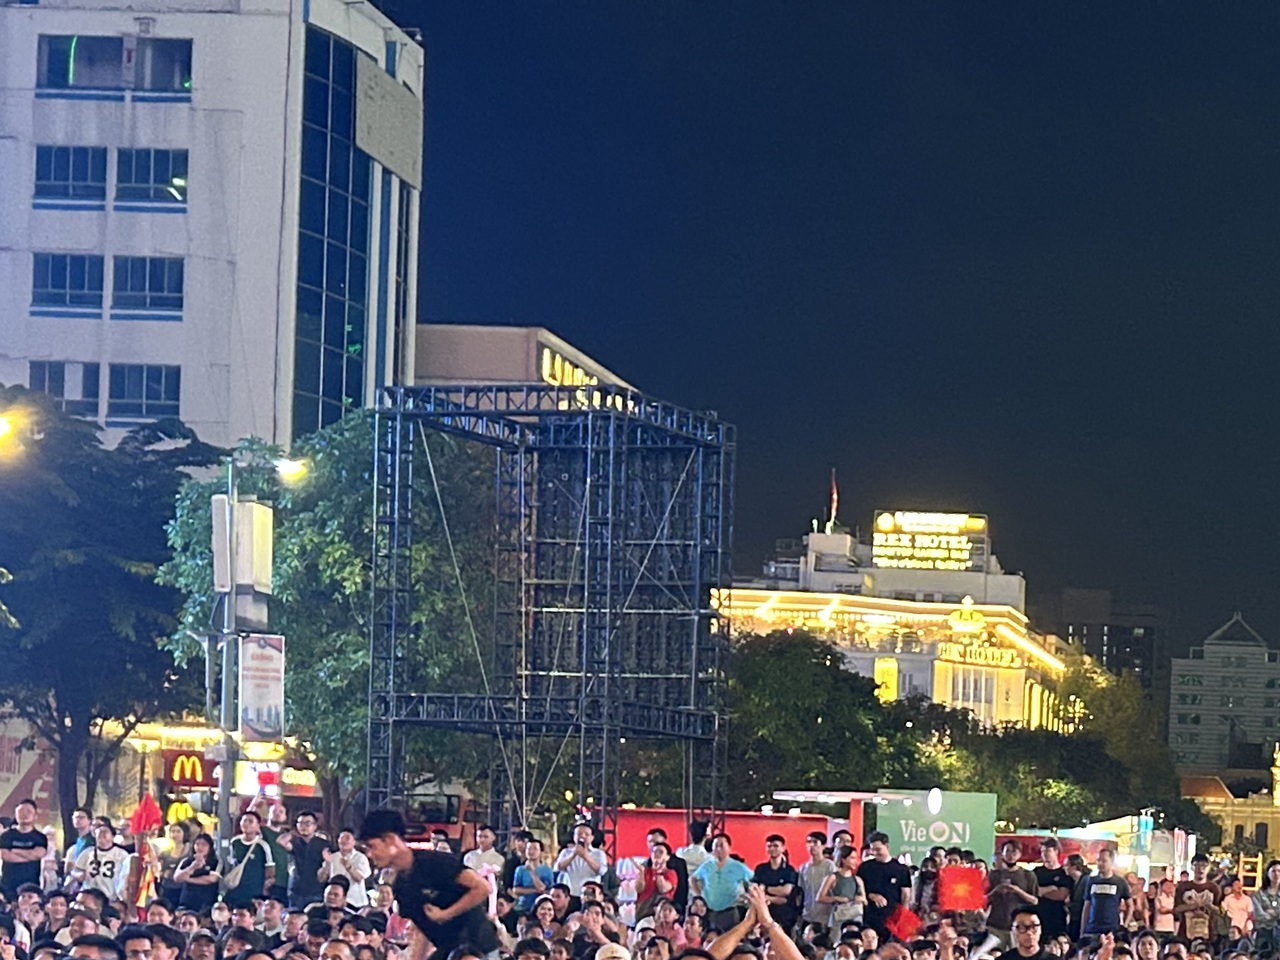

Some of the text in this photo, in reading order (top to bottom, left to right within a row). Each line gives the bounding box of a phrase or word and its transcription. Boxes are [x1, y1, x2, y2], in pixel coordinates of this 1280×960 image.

[873, 533, 972, 549] REX HOTEL
[89, 860, 115, 879] 33
